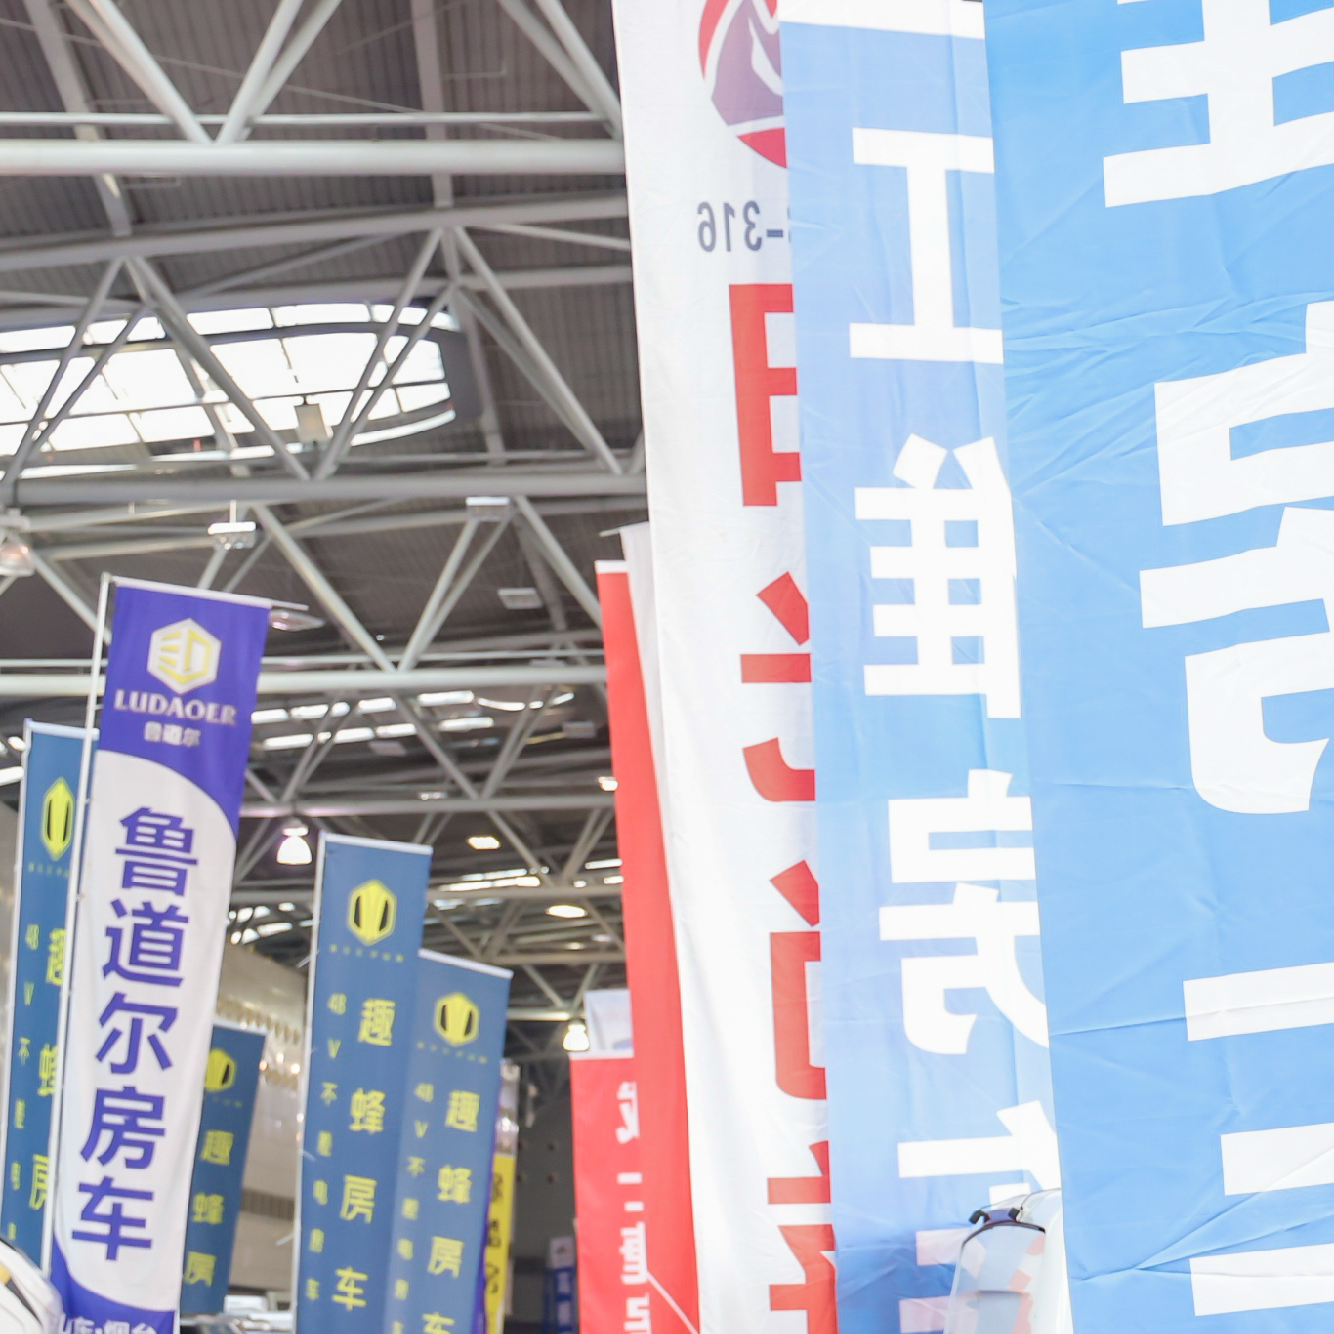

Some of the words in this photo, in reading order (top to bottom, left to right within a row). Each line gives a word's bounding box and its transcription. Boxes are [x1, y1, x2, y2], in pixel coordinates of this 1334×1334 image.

[114, 689, 237, 726] LUDAOER
[71, 805, 198, 1261] 鲁道尔房车
